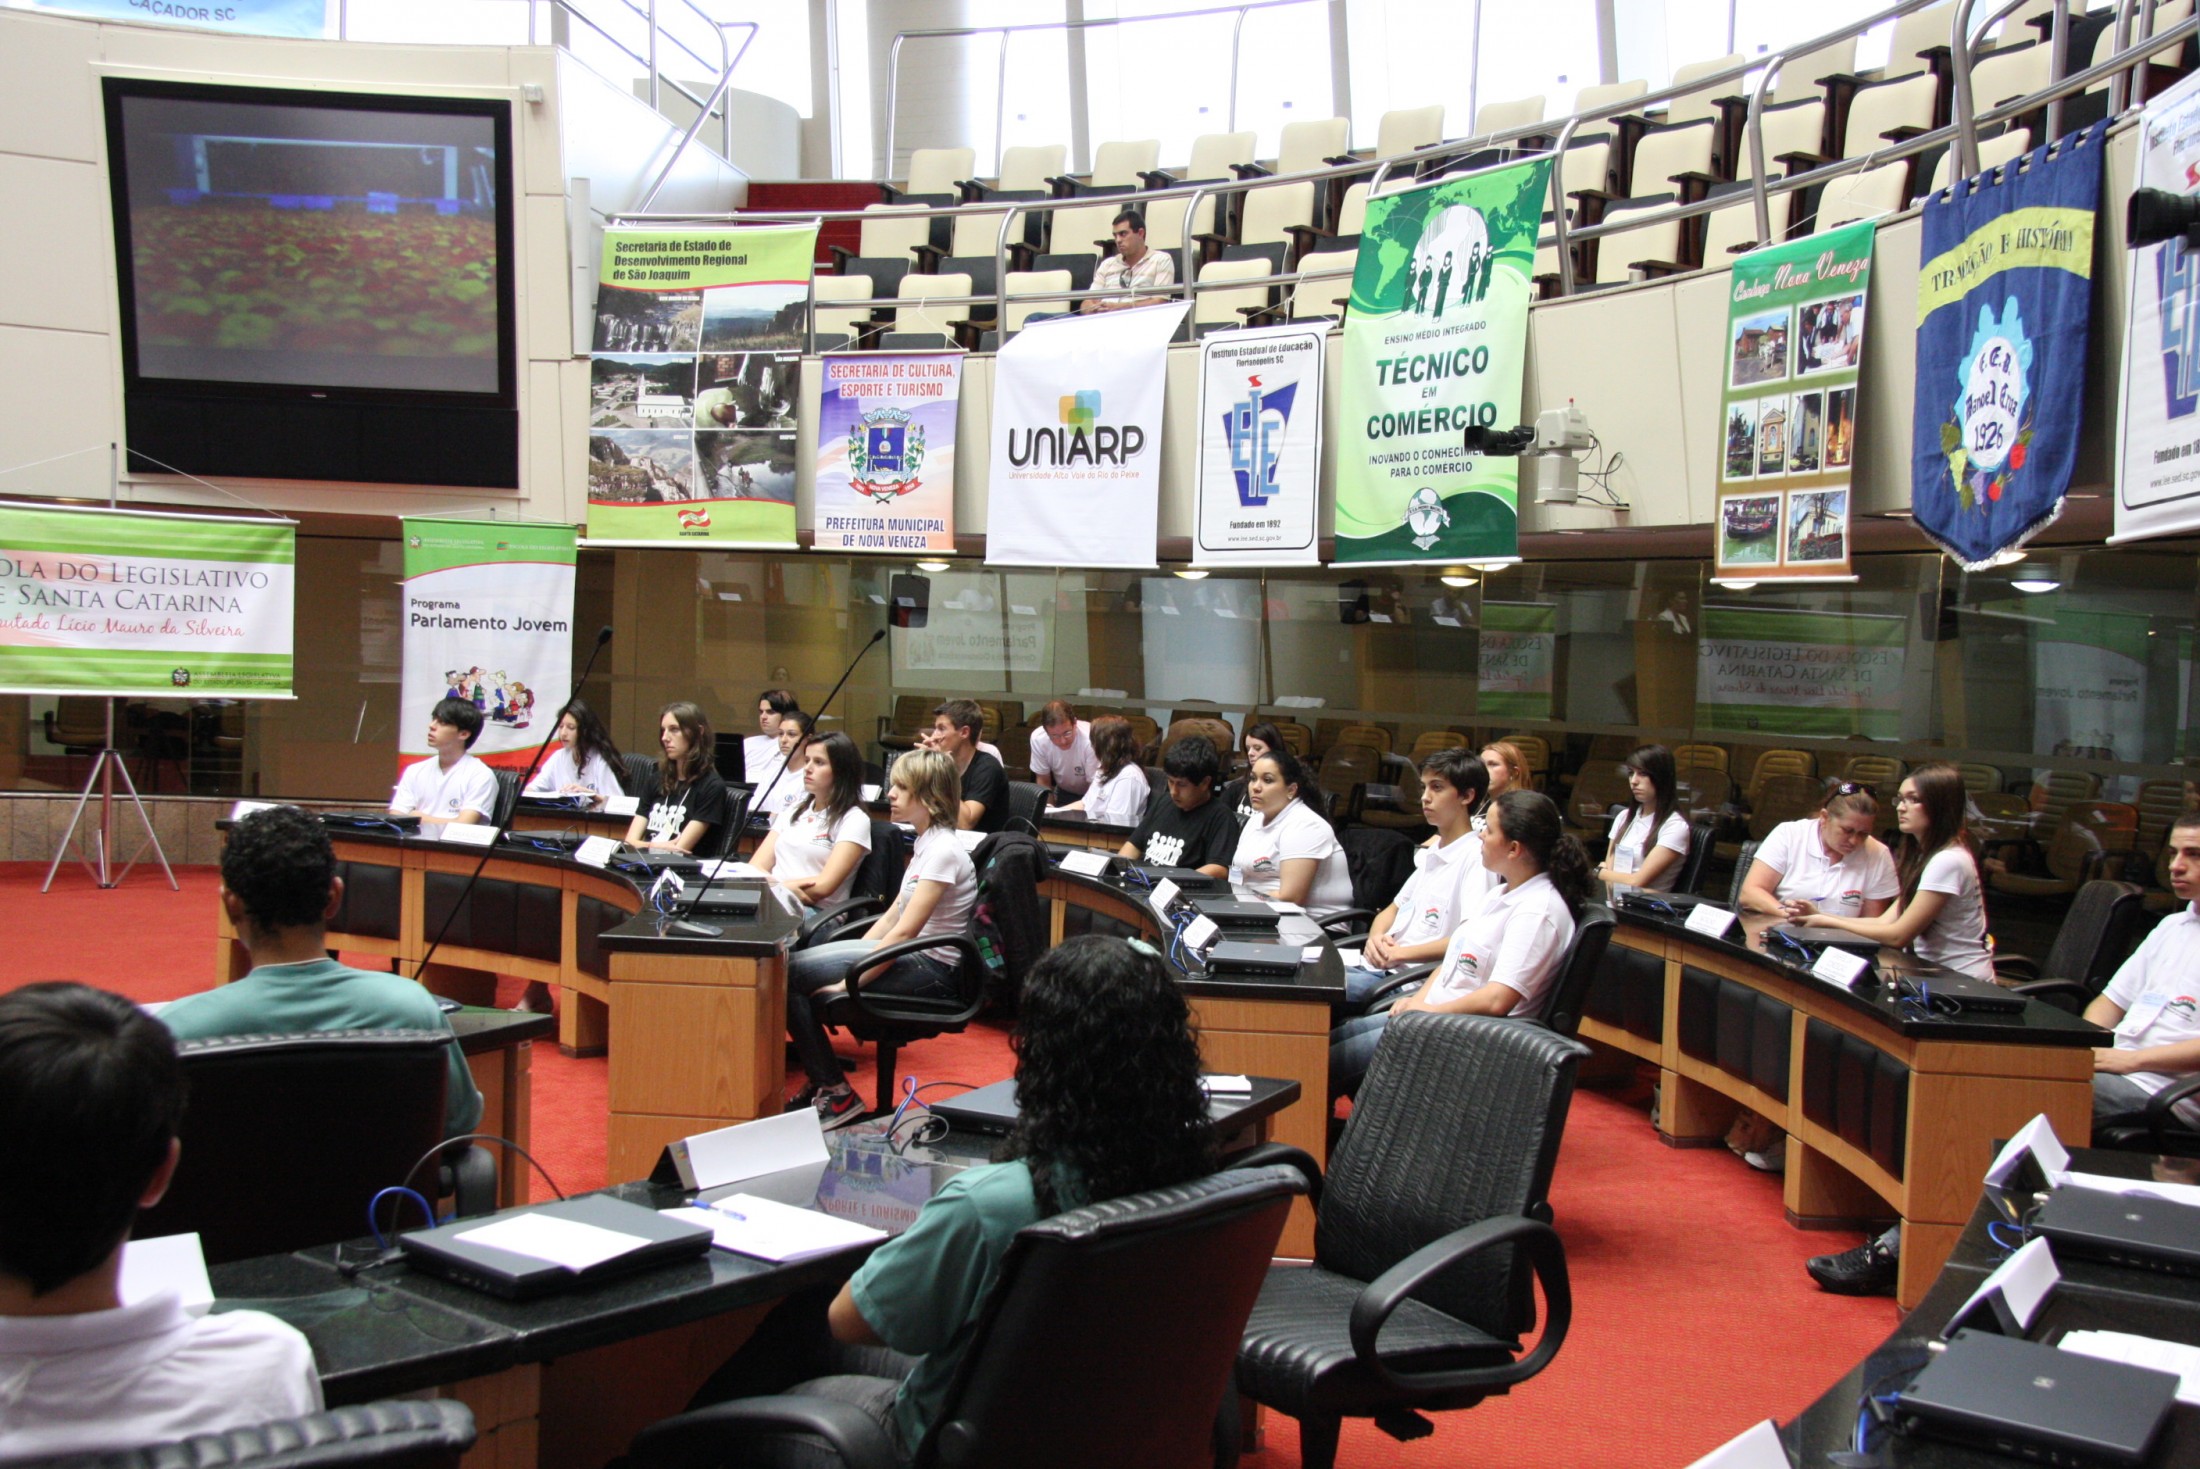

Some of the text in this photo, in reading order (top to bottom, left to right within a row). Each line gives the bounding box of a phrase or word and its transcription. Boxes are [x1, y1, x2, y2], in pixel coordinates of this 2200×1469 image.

[214, 8, 236, 21] SC
[616, 240, 731, 253] Secretaria de Estado de
[614, 254, 748, 266] Desenvolvimento Regional
[613, 269, 690, 282] de São Joaquim
[1775, 263, 1810, 290] Nova
[1816, 250, 1869, 282] Veneza
[1385, 334, 1414, 345] ENSINO
[1442, 321, 1486, 337] INTEGRADO
[1211, 341, 1313, 359] Instituto Estadual de Educação
[1275, 355, 1284, 363] SC
[1376, 345, 1489, 386] TÉCNICO
[831, 363, 955, 378] SECRETARIA DE CULTURA,
[841, 382, 943, 397] ESPORTE E TURISMO
[1421, 386, 1437, 398] EM
[1367, 402, 1497, 439] COMÉRCIO
[1974, 421, 2004, 451] 1926
[1369, 450, 1411, 465] INOVANDO
[1413, 450, 1420, 461] O
[2153, 446, 2180, 464] Fundado
[2181, 443, 2191, 457] em
[1009, 471, 1051, 480] Universidade
[1121, 469, 1140, 478] Peixe
[1390, 465, 1411, 478] PARA
[1414, 465, 1420, 476] O
[826, 517, 945, 532] PREFEITURA MUNICIPAL
[1230, 519, 1281, 529] Fundado em 1892
[842, 534, 927, 548] DE NOVA VENEZA
[58, 562, 99, 582] DO
[111, 562, 269, 590] LEGISLATIVO
[18, 584, 105, 609] SANTA
[115, 589, 243, 614] CATARINA
[411, 598, 461, 610] Programa
[100, 617, 155, 635] Mauro
[160, 618, 180, 635] da
[183, 618, 246, 637] Silveira
[411, 612, 567, 632] Parlamento Jovem
